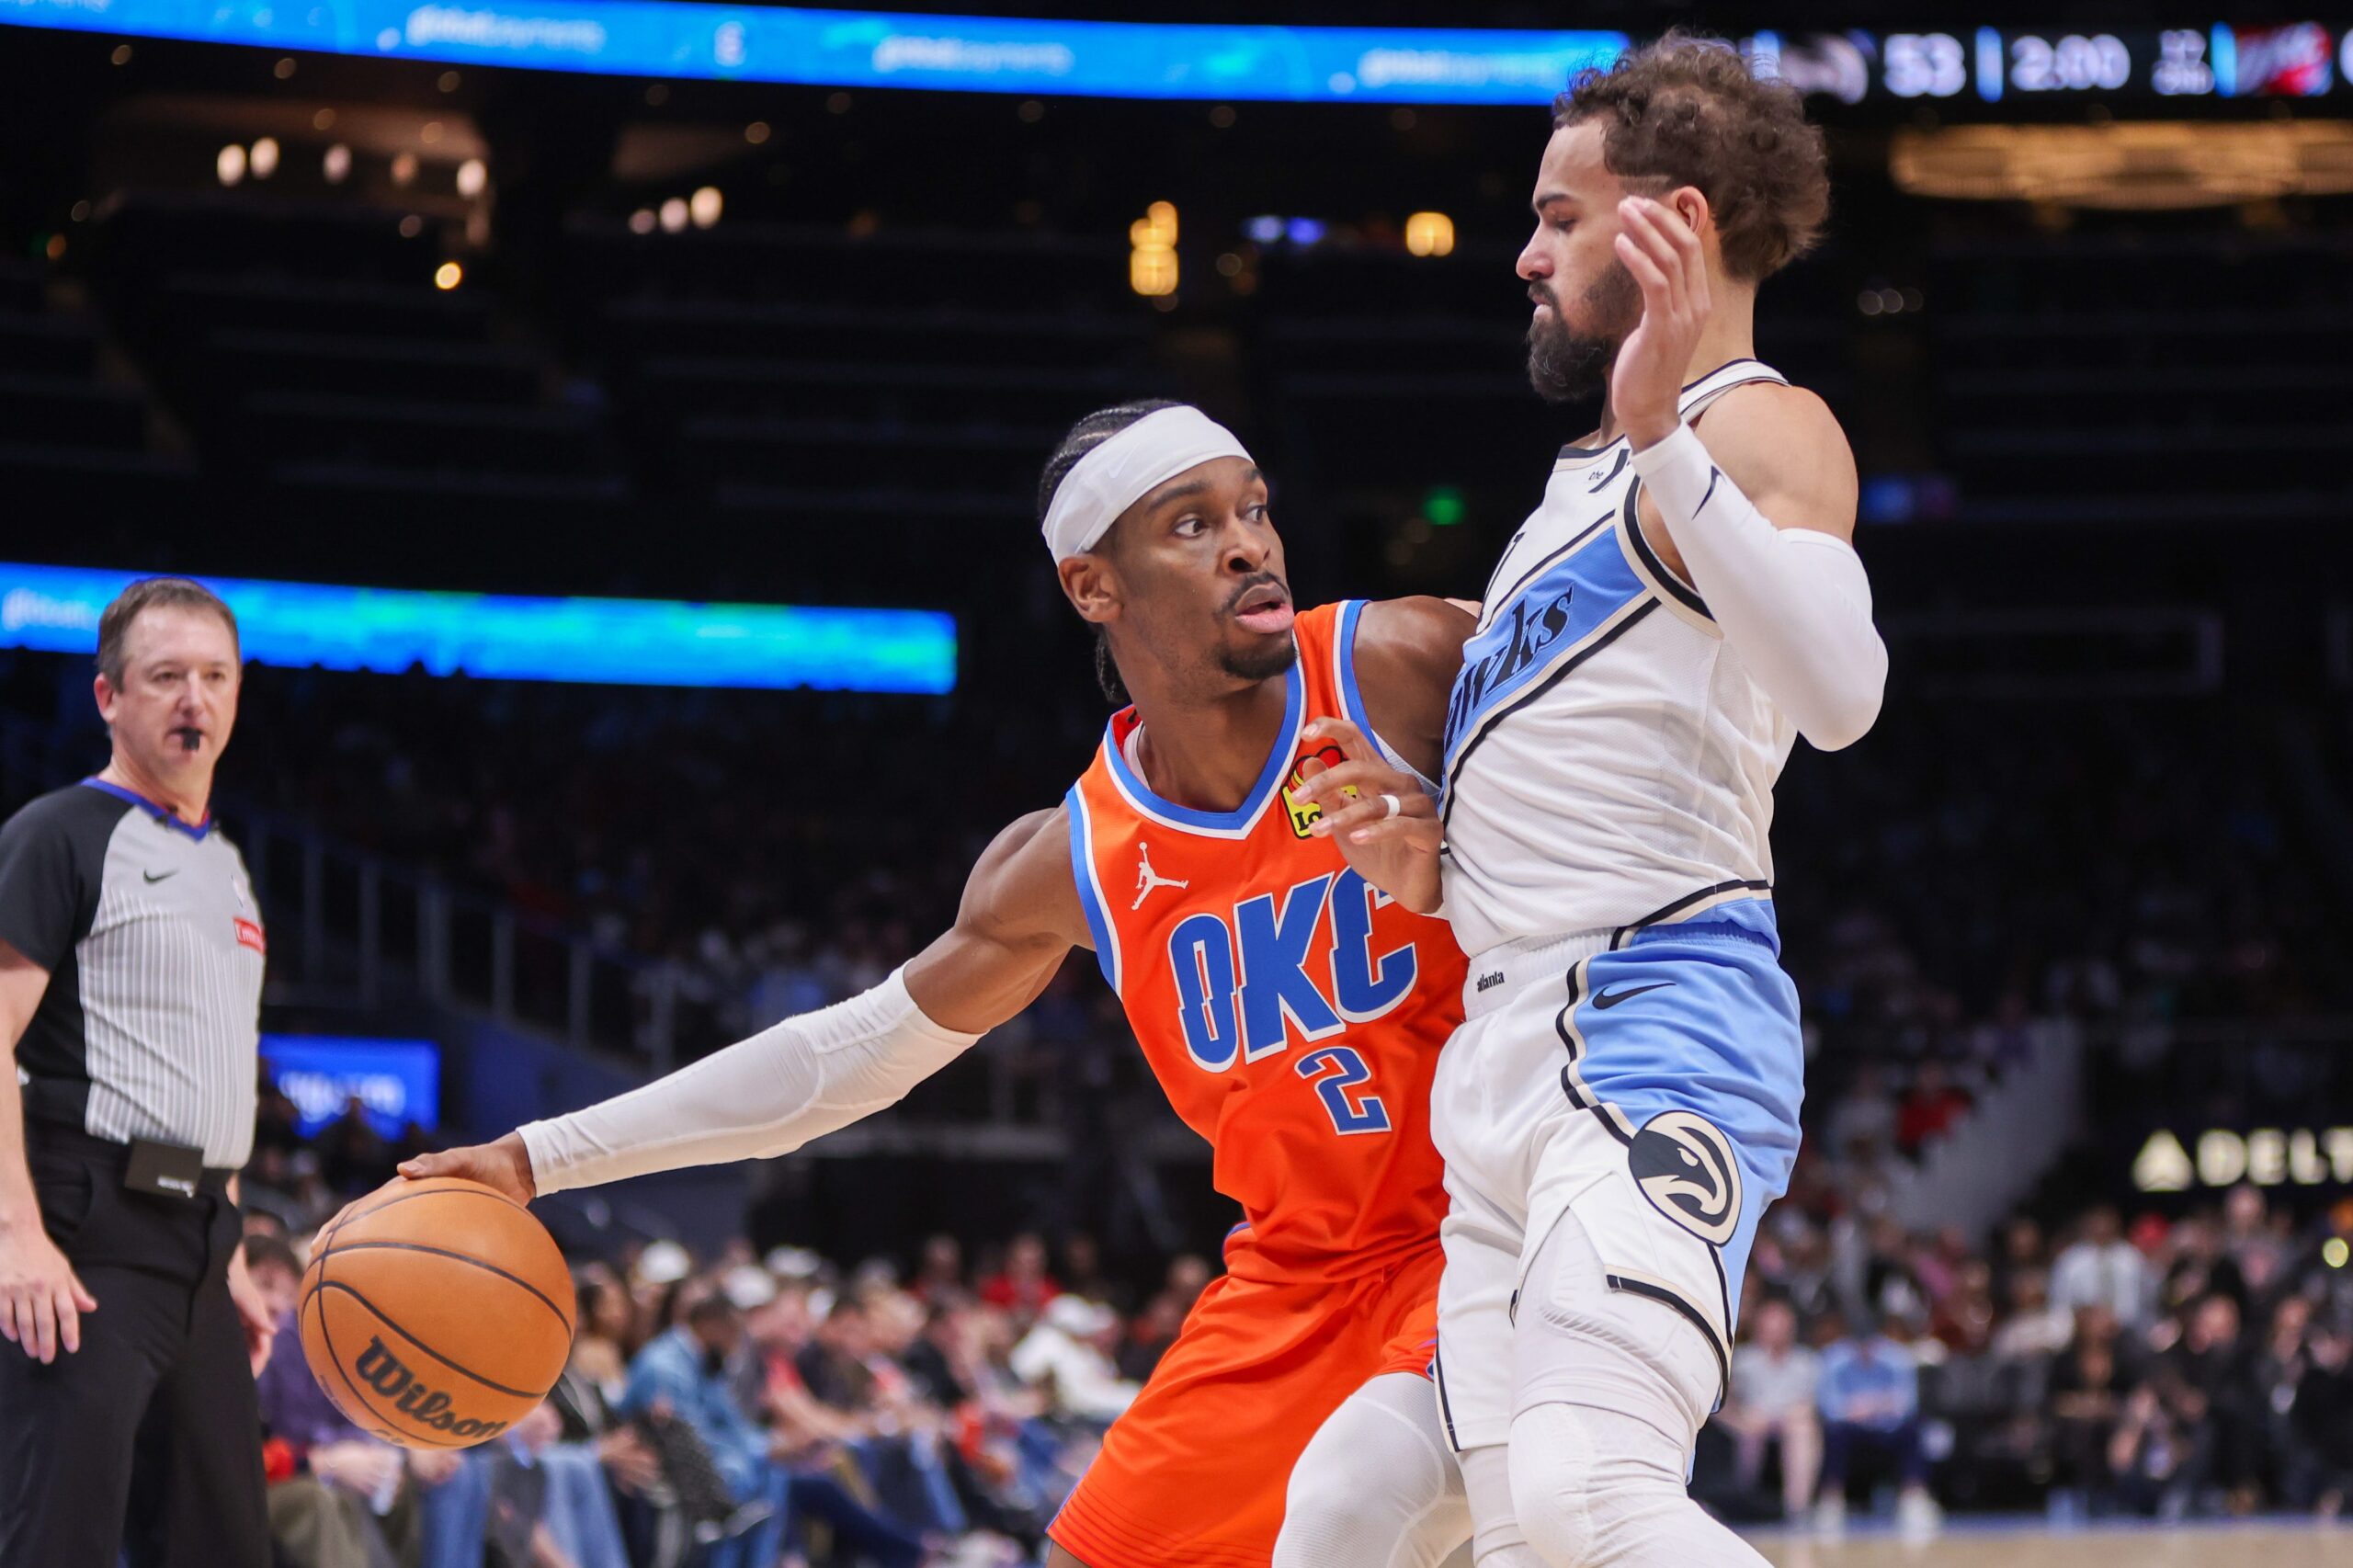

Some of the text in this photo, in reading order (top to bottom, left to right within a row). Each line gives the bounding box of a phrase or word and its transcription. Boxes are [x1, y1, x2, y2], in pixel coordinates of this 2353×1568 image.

[1883, 33, 1966, 97] 53
[1167, 865, 1418, 1074] OKC
[1477, 971, 1505, 993] atlanta
[1294, 1046, 1392, 1136] 2
[356, 1335, 508, 1438] Wilson
